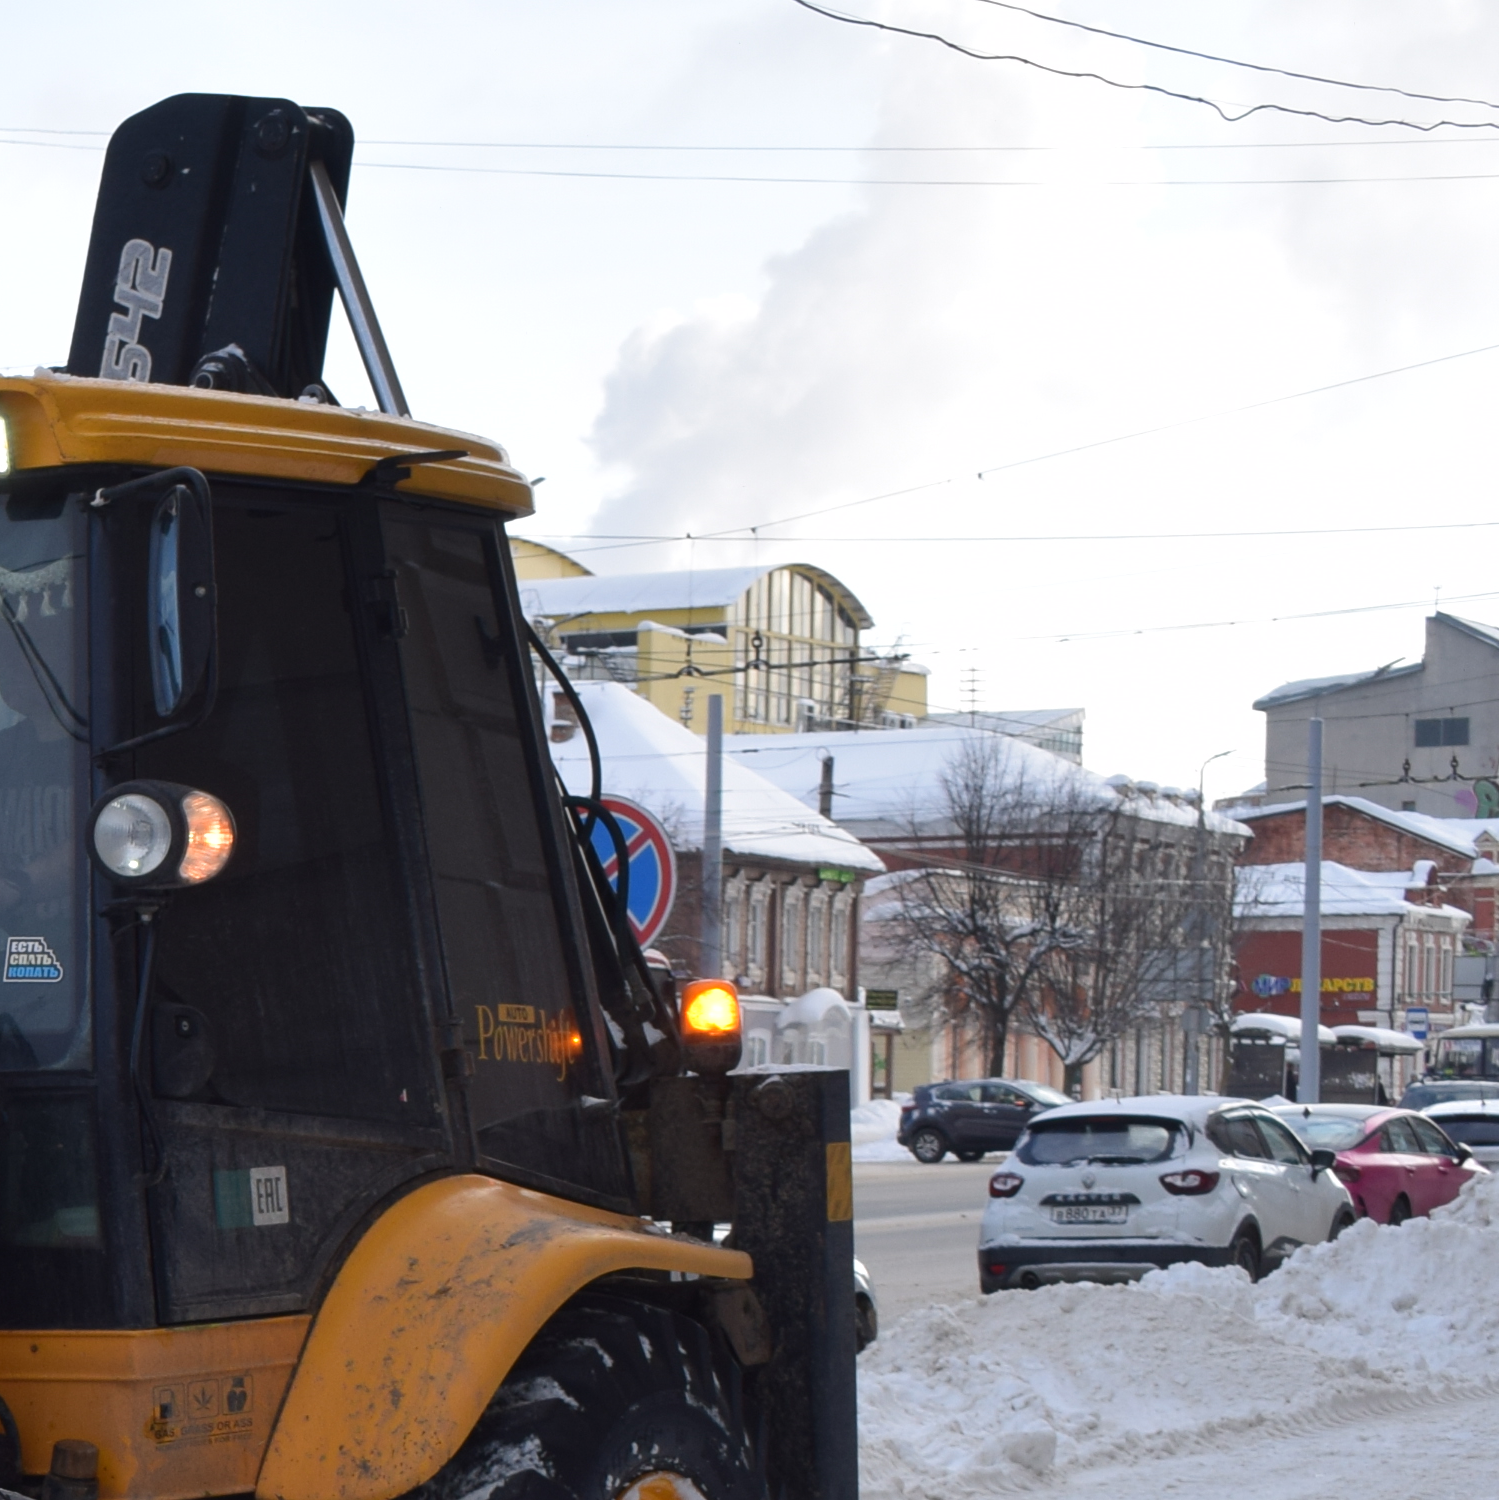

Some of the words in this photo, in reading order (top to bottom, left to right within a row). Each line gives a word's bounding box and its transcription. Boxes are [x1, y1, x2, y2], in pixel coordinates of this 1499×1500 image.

[11, 941, 43, 953] ЕСТЬ
[9, 954, 52, 965] СПАТЬ
[8, 966, 59, 978] КОПАТЬ
[1290, 977, 1374, 992] ЛАРСТВ
[475, 1005, 575, 1082] Powershift
[256, 1177, 283, 1214] EAC
[217, 1420, 231, 1432] OR
[233, 1418, 253, 1430] ASS
